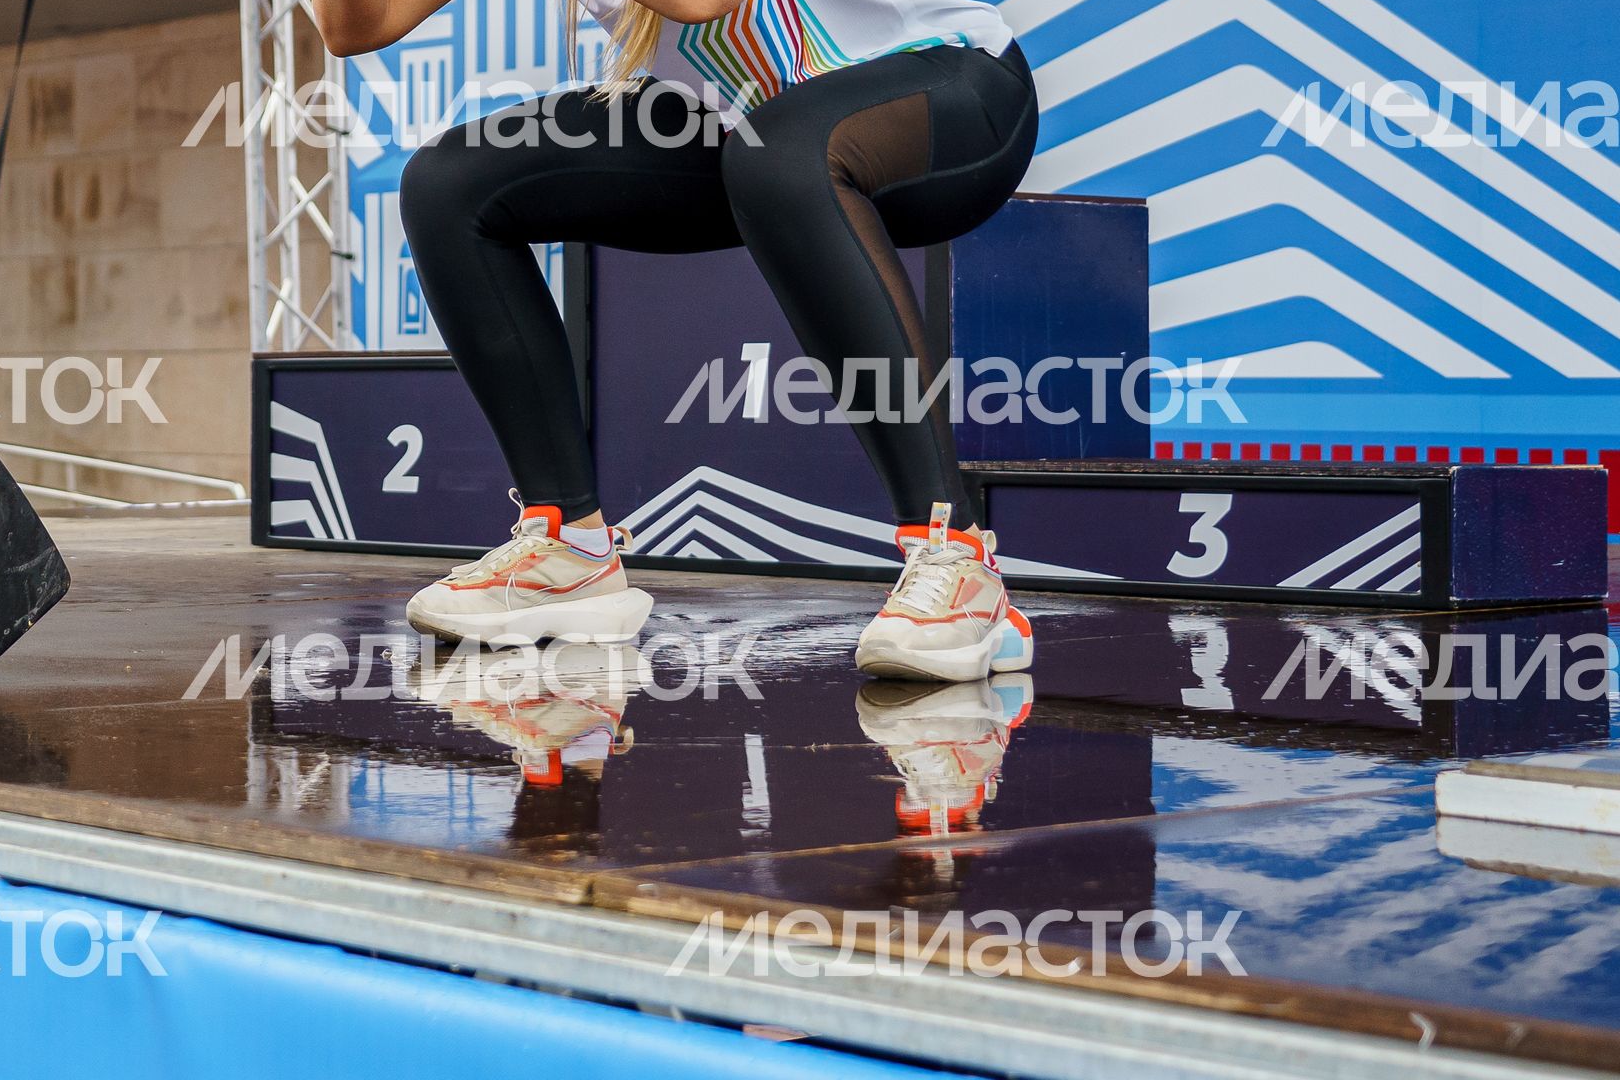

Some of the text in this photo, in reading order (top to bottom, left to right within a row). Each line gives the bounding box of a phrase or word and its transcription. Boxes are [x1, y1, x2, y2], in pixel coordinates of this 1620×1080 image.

[741, 342, 771, 419] 1
[383, 425, 423, 494] 2
[1168, 492, 1233, 578] 3
